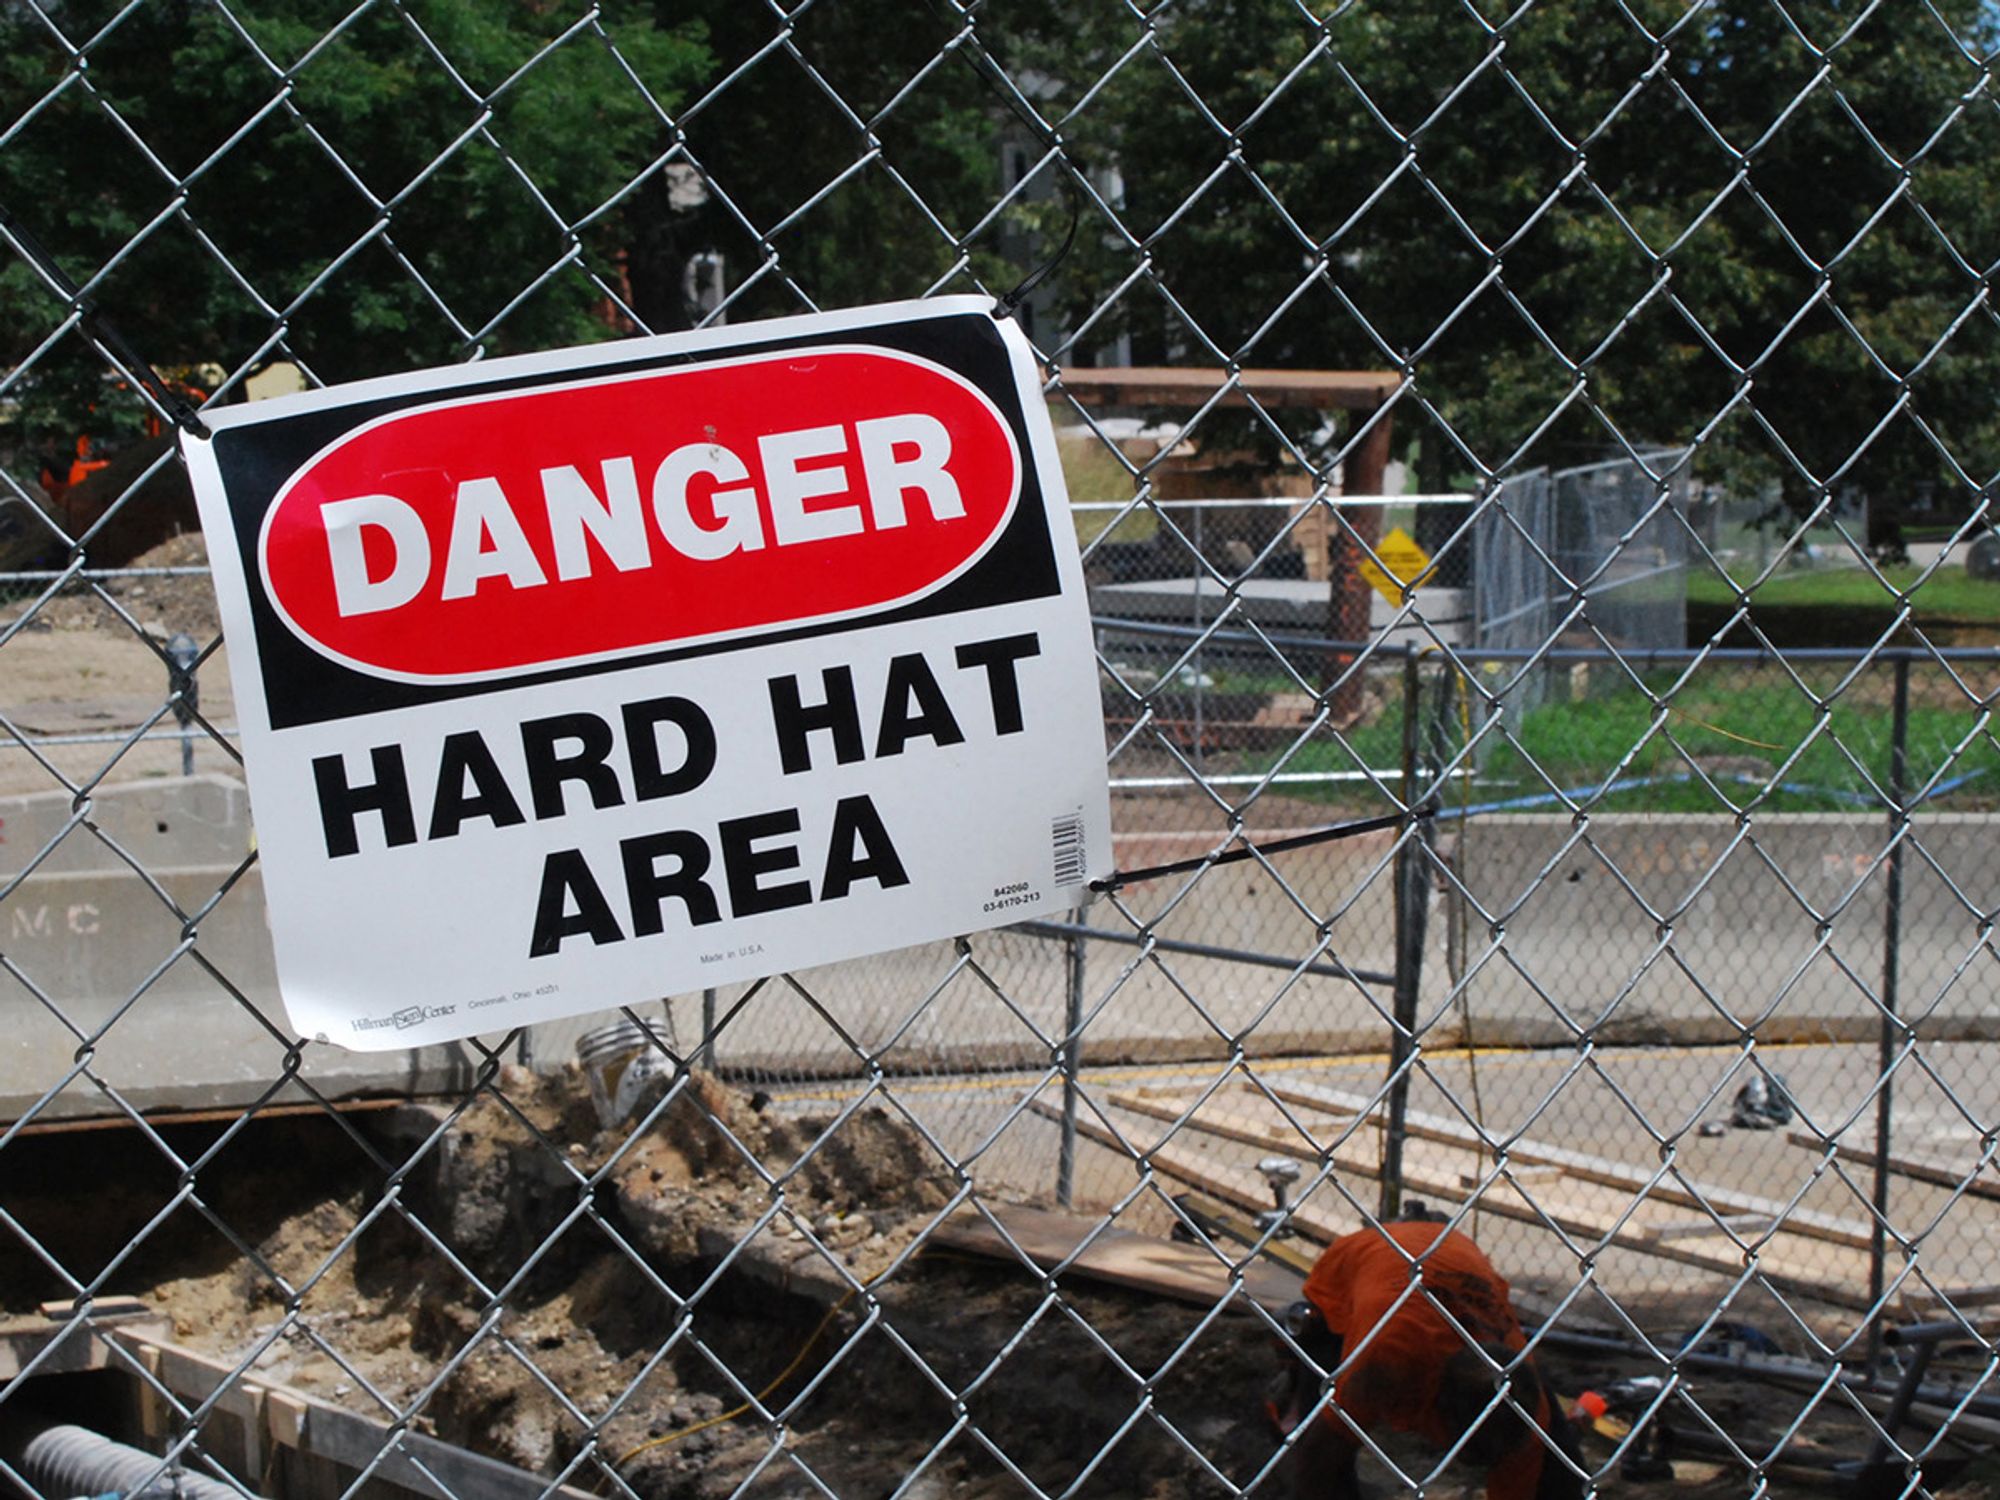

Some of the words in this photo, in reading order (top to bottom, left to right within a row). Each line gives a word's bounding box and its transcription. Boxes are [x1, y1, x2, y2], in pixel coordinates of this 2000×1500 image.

[320, 414, 966, 617] DANGER
[312, 697, 717, 858] HARD
[769, 632, 1041, 775] HAT
[530, 795, 910, 958] AREA
[983, 891, 1041, 913] 03-6170-213
[512, 991, 532, 1001] Ohio
[700, 953, 723, 964] Made
[727, 951, 737, 959] in
